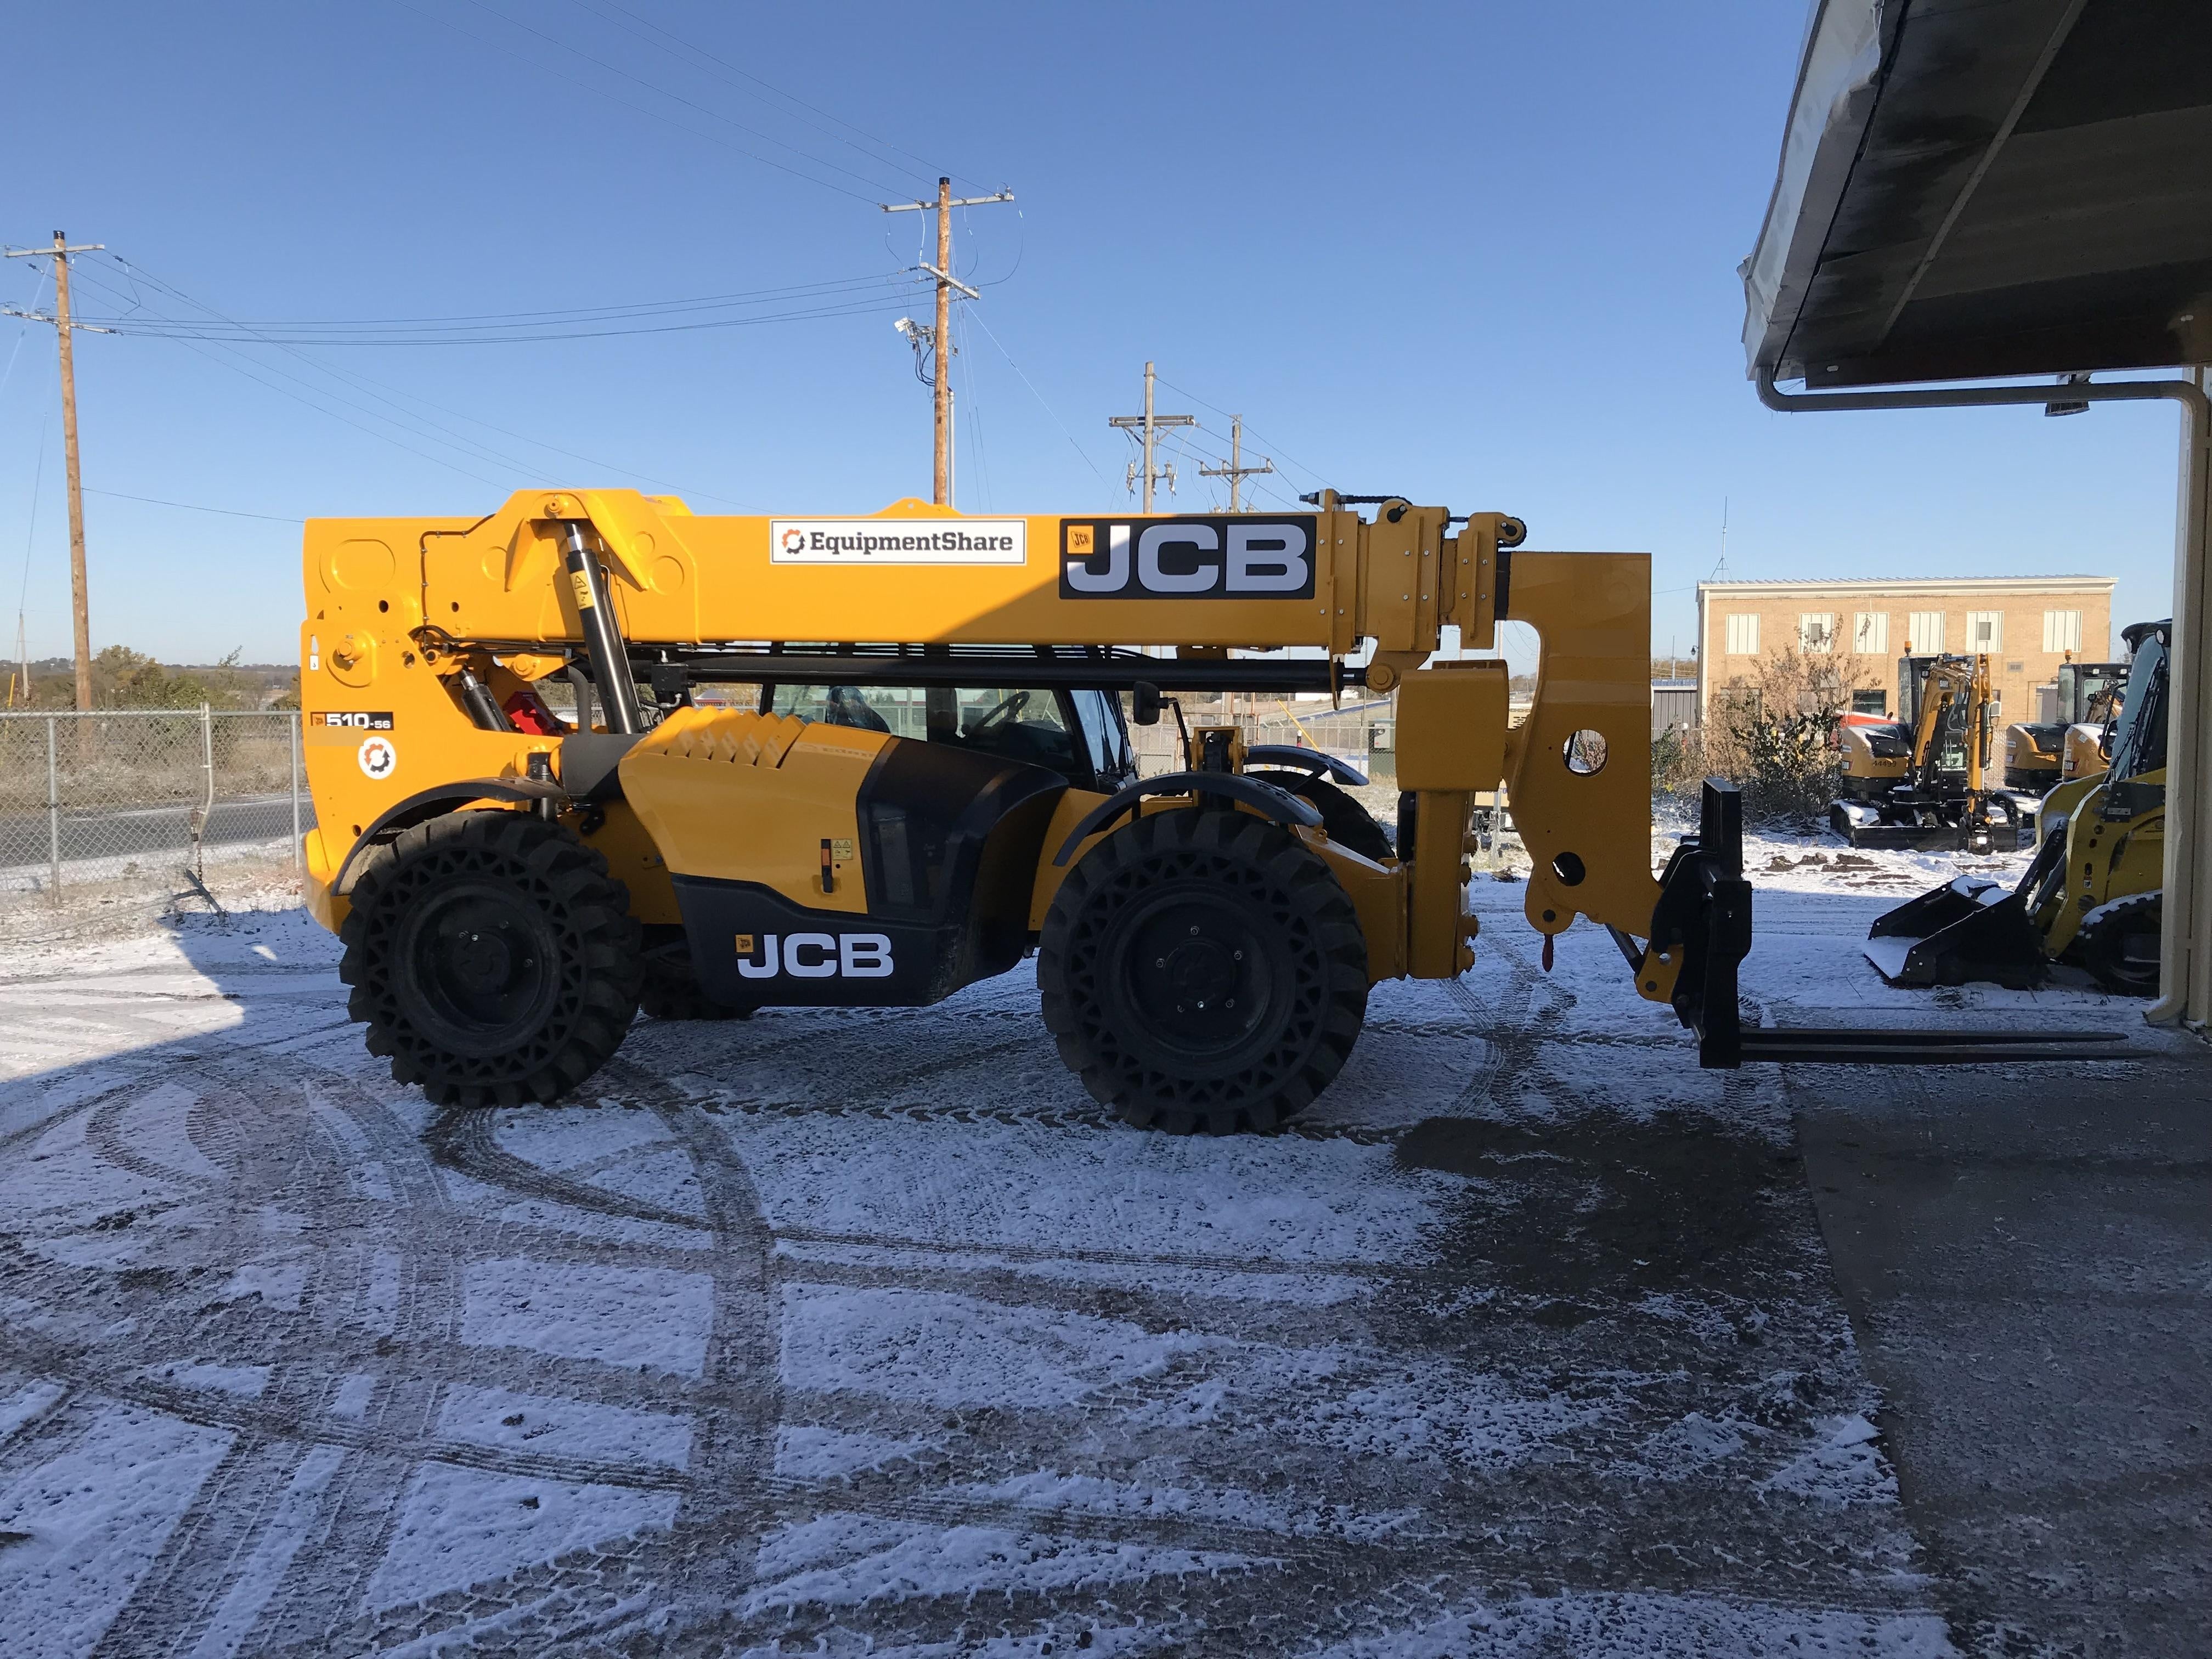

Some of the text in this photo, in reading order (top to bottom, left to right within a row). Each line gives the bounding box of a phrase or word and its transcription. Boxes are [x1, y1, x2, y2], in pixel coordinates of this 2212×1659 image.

[810, 532, 1013, 555] EquipmentShare
[1074, 533, 1089, 546] JCB
[1067, 524, 1308, 592] JCB
[326, 713, 391, 729] 510-56
[737, 933, 894, 978] JCB
